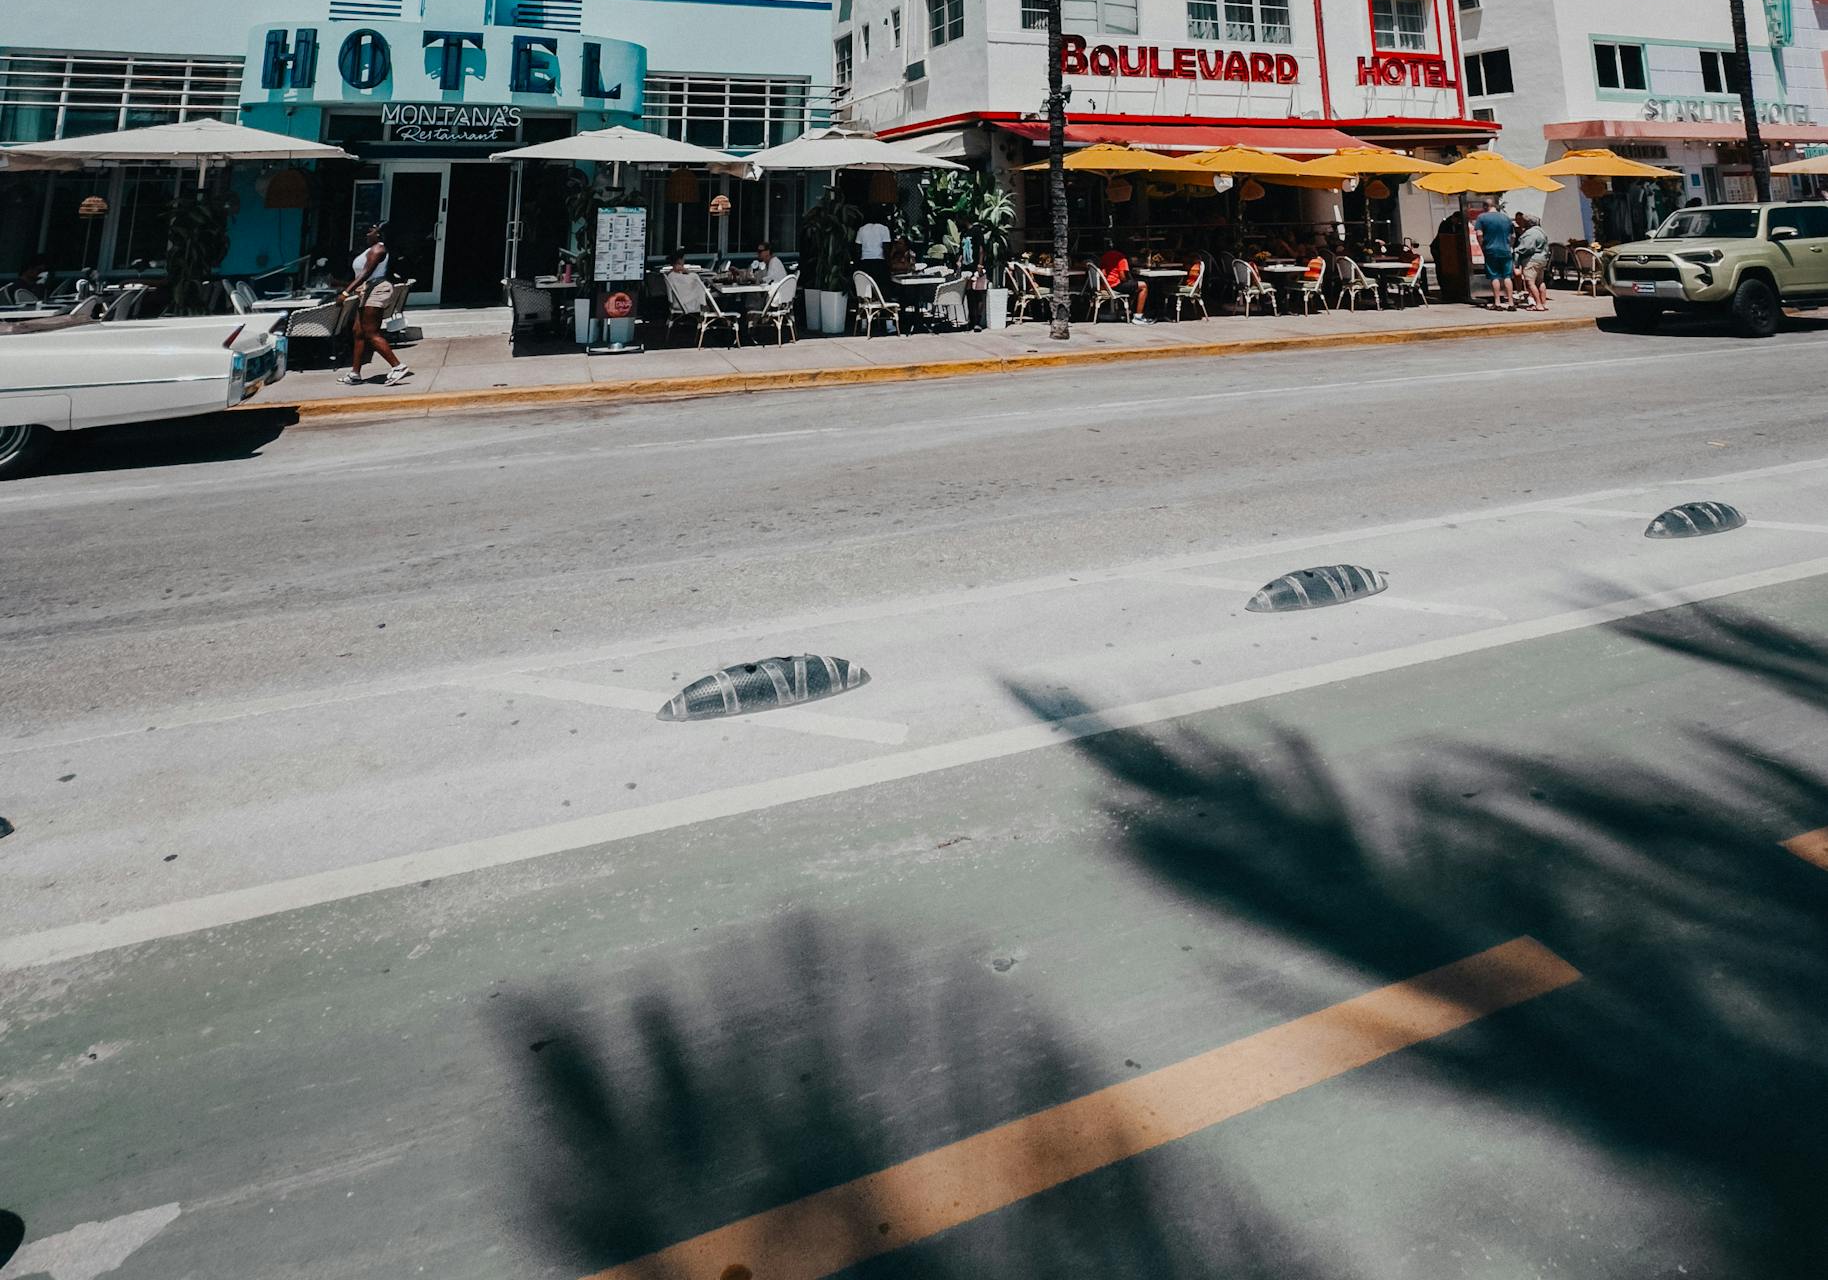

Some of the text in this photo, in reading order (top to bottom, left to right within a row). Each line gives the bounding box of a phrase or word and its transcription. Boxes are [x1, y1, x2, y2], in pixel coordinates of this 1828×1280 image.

[261, 27, 621, 100] HOTEL
[1060, 33, 1457, 89] BOULEVARD HOTEL
[381, 103, 521, 127] MONTANA'S
[1641, 98, 1743, 123] STARLITE
[396, 124, 504, 143] Restaurant
